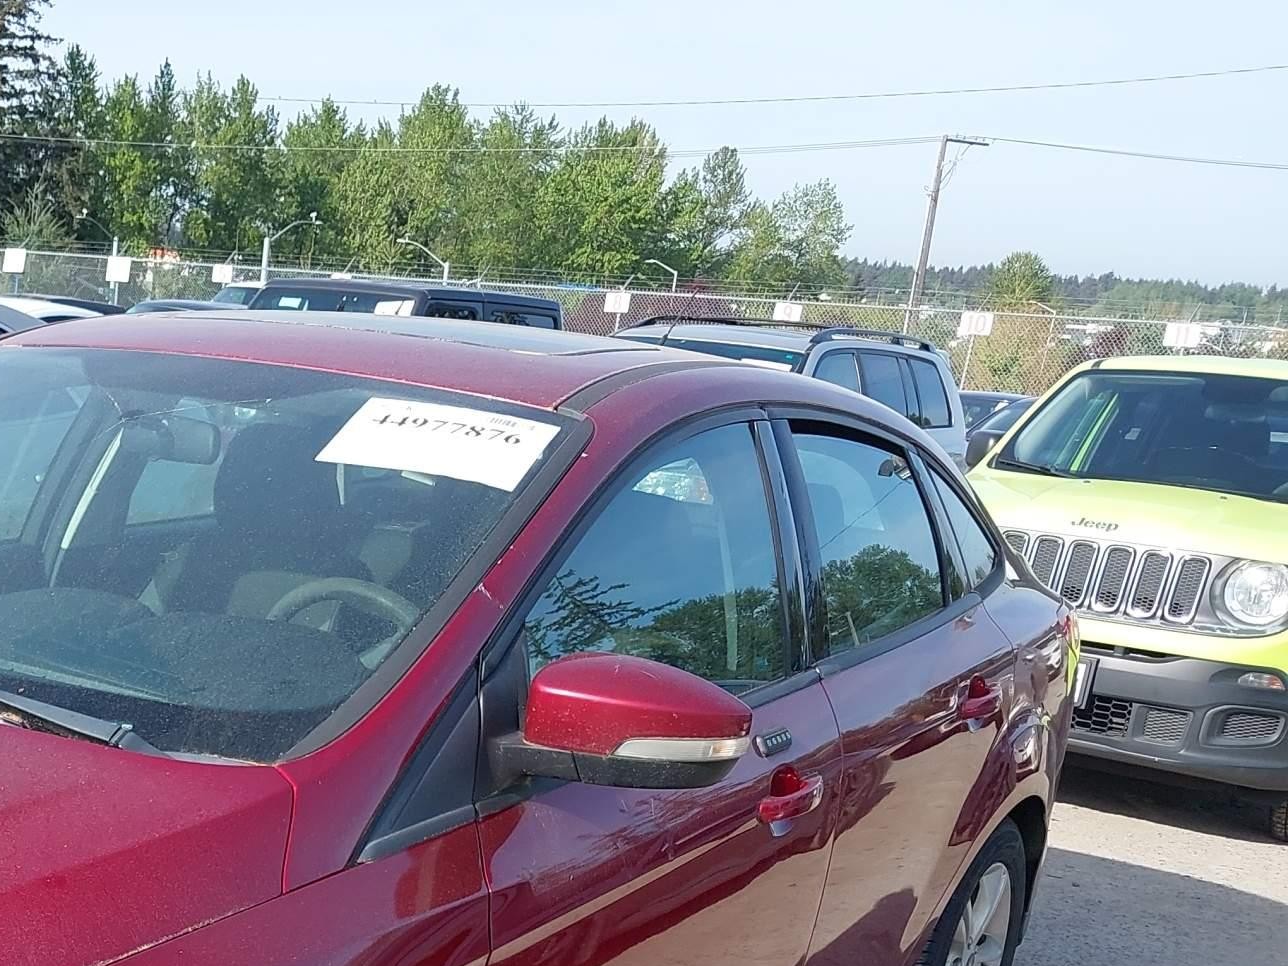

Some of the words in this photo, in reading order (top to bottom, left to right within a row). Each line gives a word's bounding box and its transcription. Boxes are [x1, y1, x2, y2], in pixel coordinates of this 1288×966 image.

[967, 314, 988, 333] 10
[1175, 326, 1190, 344] 11
[371, 413, 521, 445] 44977876
[1071, 517, 1119, 532] Jeep
